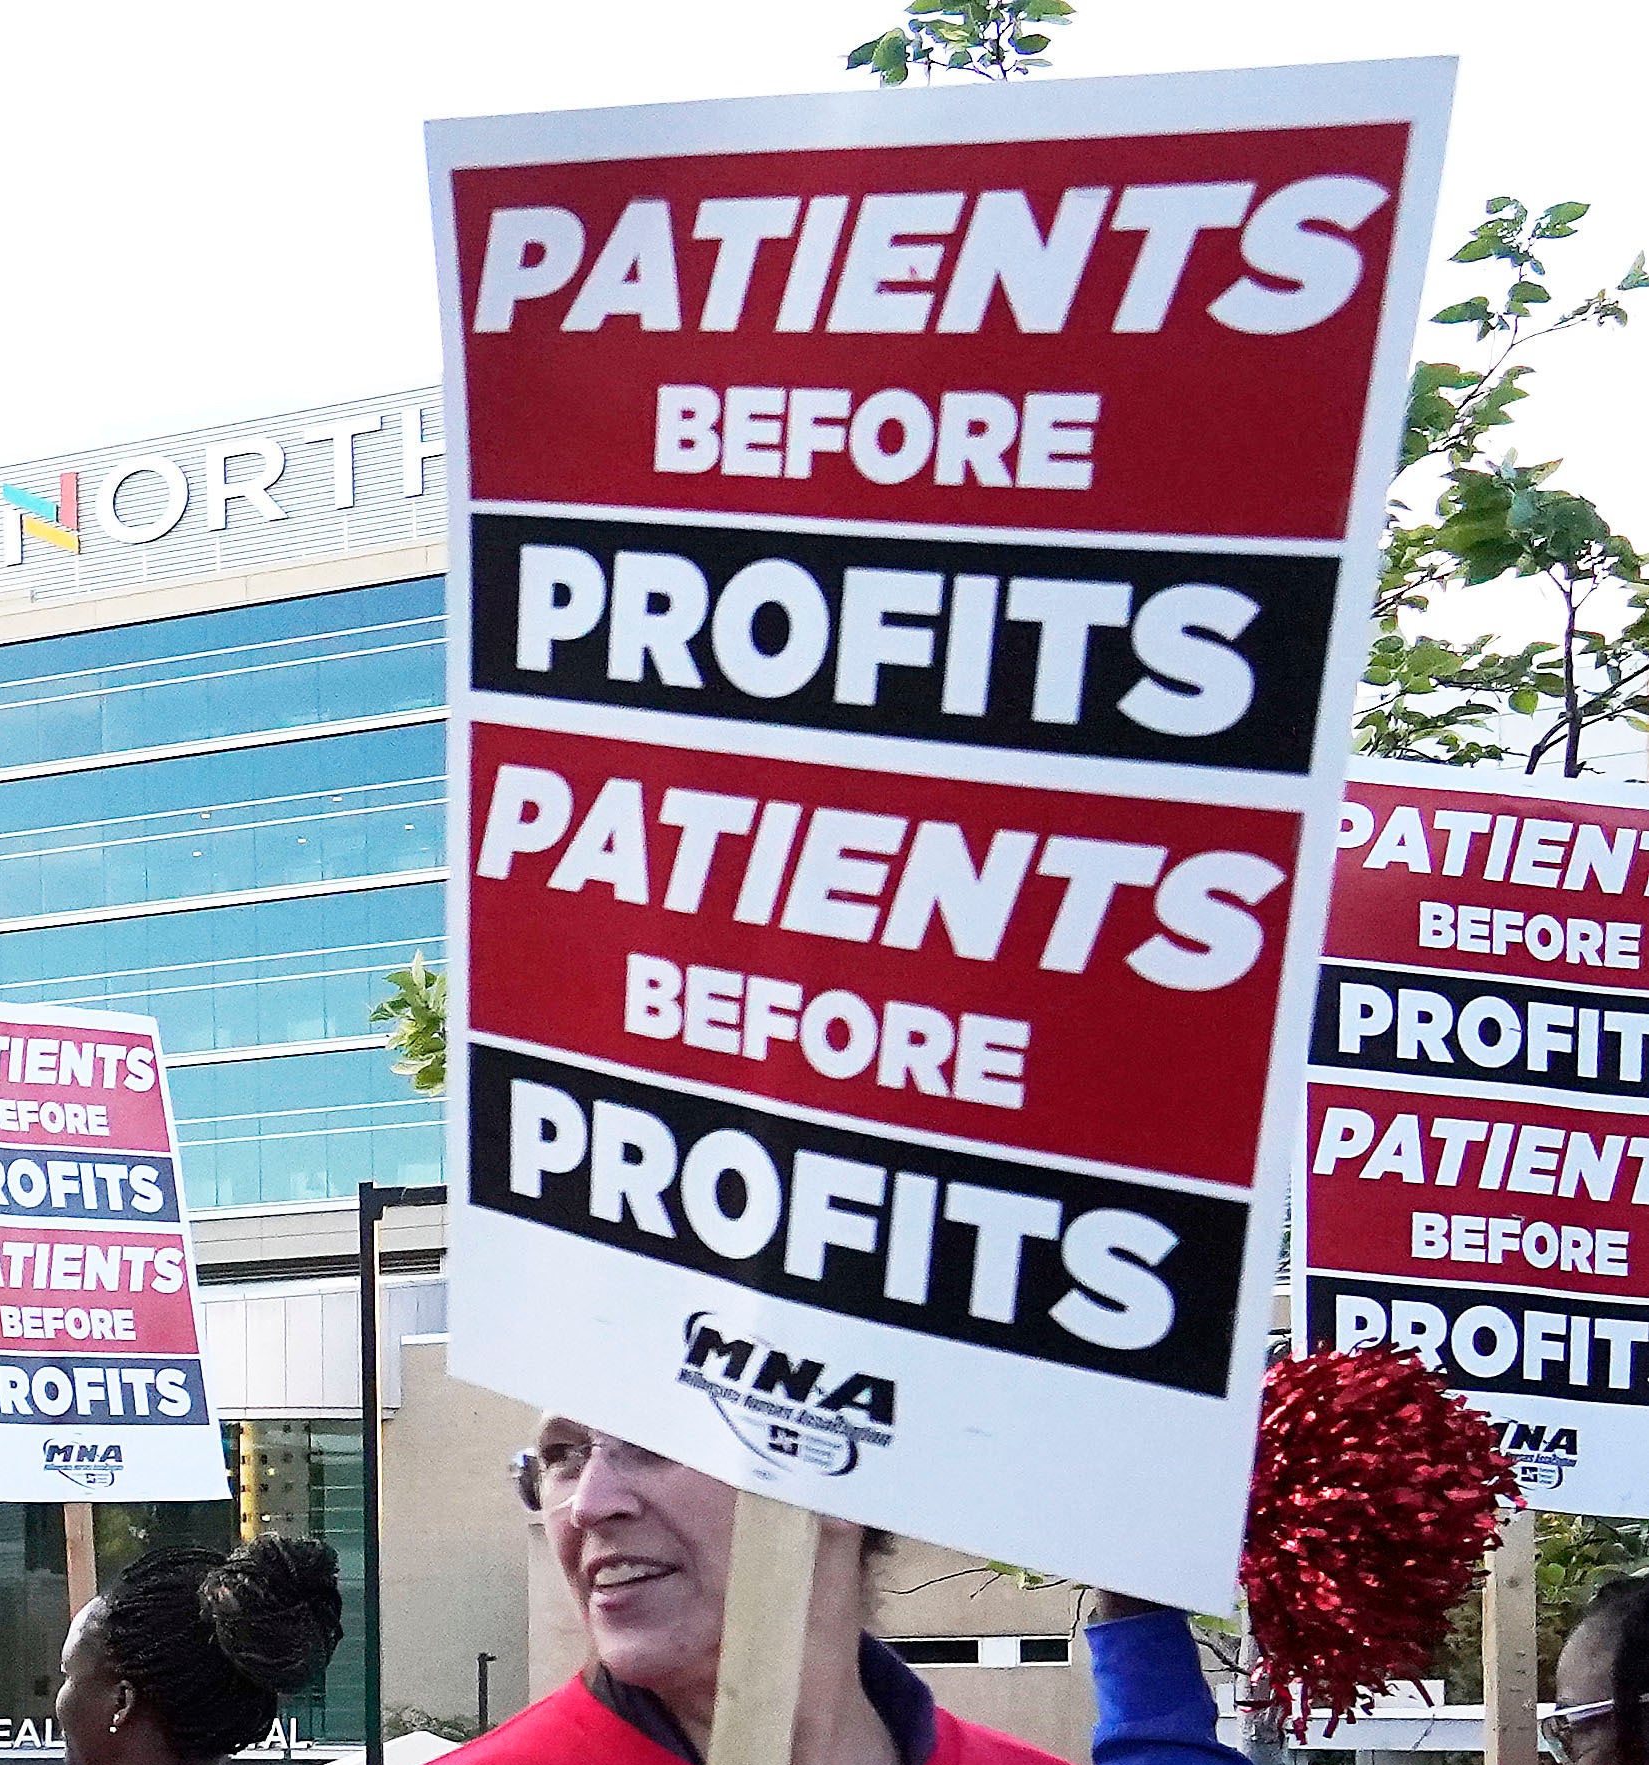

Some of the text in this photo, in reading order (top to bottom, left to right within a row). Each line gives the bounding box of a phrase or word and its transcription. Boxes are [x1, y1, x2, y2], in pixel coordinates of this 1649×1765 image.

[473, 174, 1390, 334] PATIENTS
[653, 384, 1100, 489] BEFORE
[515, 544, 1261, 737] PROFITS
[476, 765, 1287, 991] PATIENTS
[1335, 801, 1649, 896] PATIEN
[1419, 901, 1642, 969] BEFORE
[623, 952, 1031, 1110] BEFORE
[509, 1078, 1179, 1351] PROFITS
[1412, 1213, 1629, 1277] BEFORE
[0, 1305, 136, 1340] BEFORE
[683, 1326, 896, 1426] MNA
[44, 1444, 123, 1464] MNA
